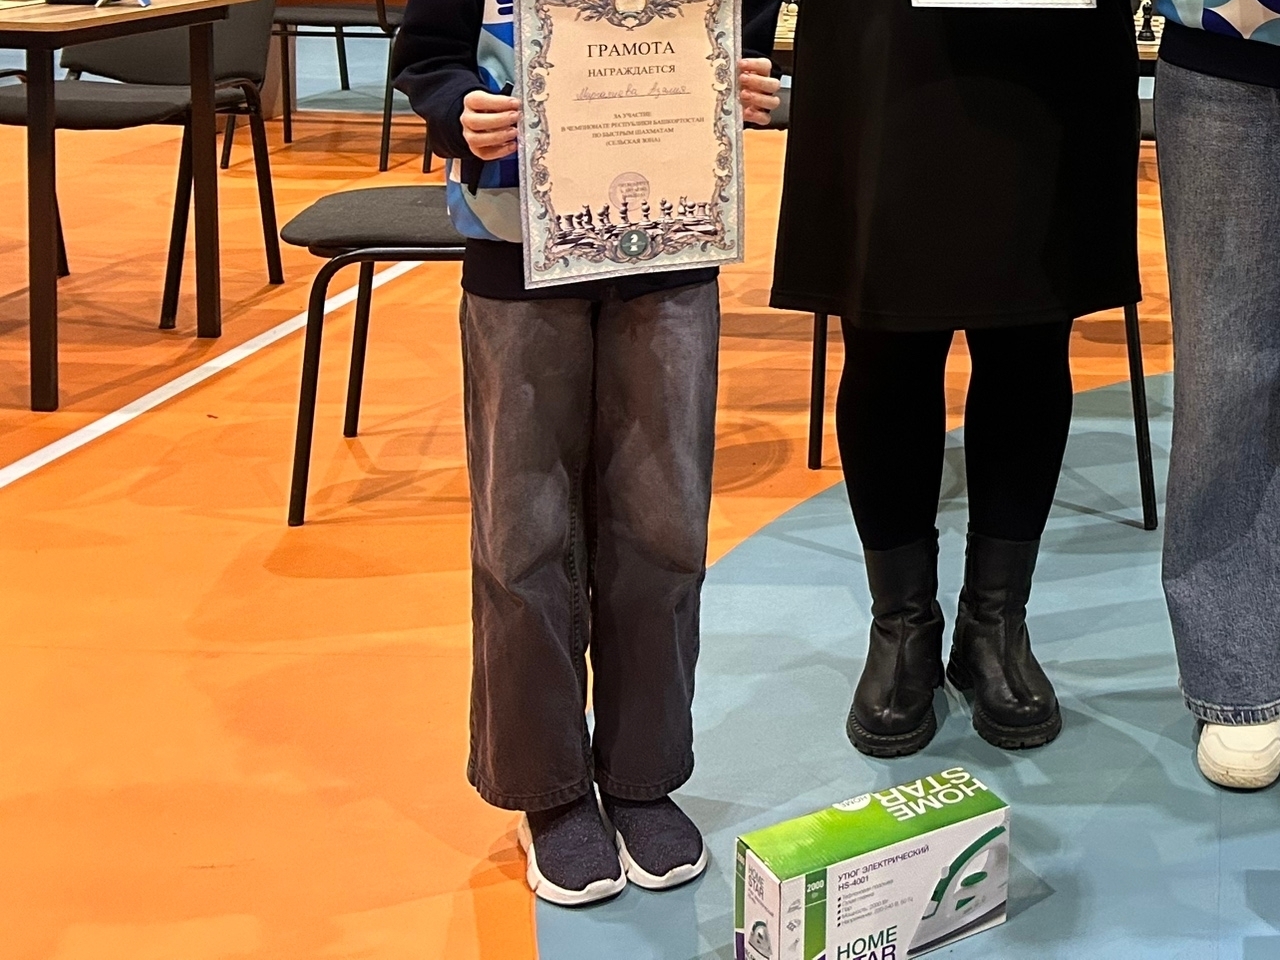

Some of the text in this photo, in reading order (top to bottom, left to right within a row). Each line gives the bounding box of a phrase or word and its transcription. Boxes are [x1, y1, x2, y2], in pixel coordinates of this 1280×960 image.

[587, 41, 676, 58] ГРАМОТА
[588, 64, 676, 78] НАГРАЖДАЕТСЯ
[653, 117, 705, 126] БАШКОРТОСТАН
[635, 127, 674, 136] ШАХМАТАМ
[870, 767, 971, 807] STAR
[886, 778, 988, 821] HOME
[838, 844, 930, 883] УТЮГ ЭЛЕКТРИЧЕСКИЙ
[806, 879, 825, 893] 2000
[838, 875, 869, 891] HS-4001
[837, 925, 897, 960] HOME
